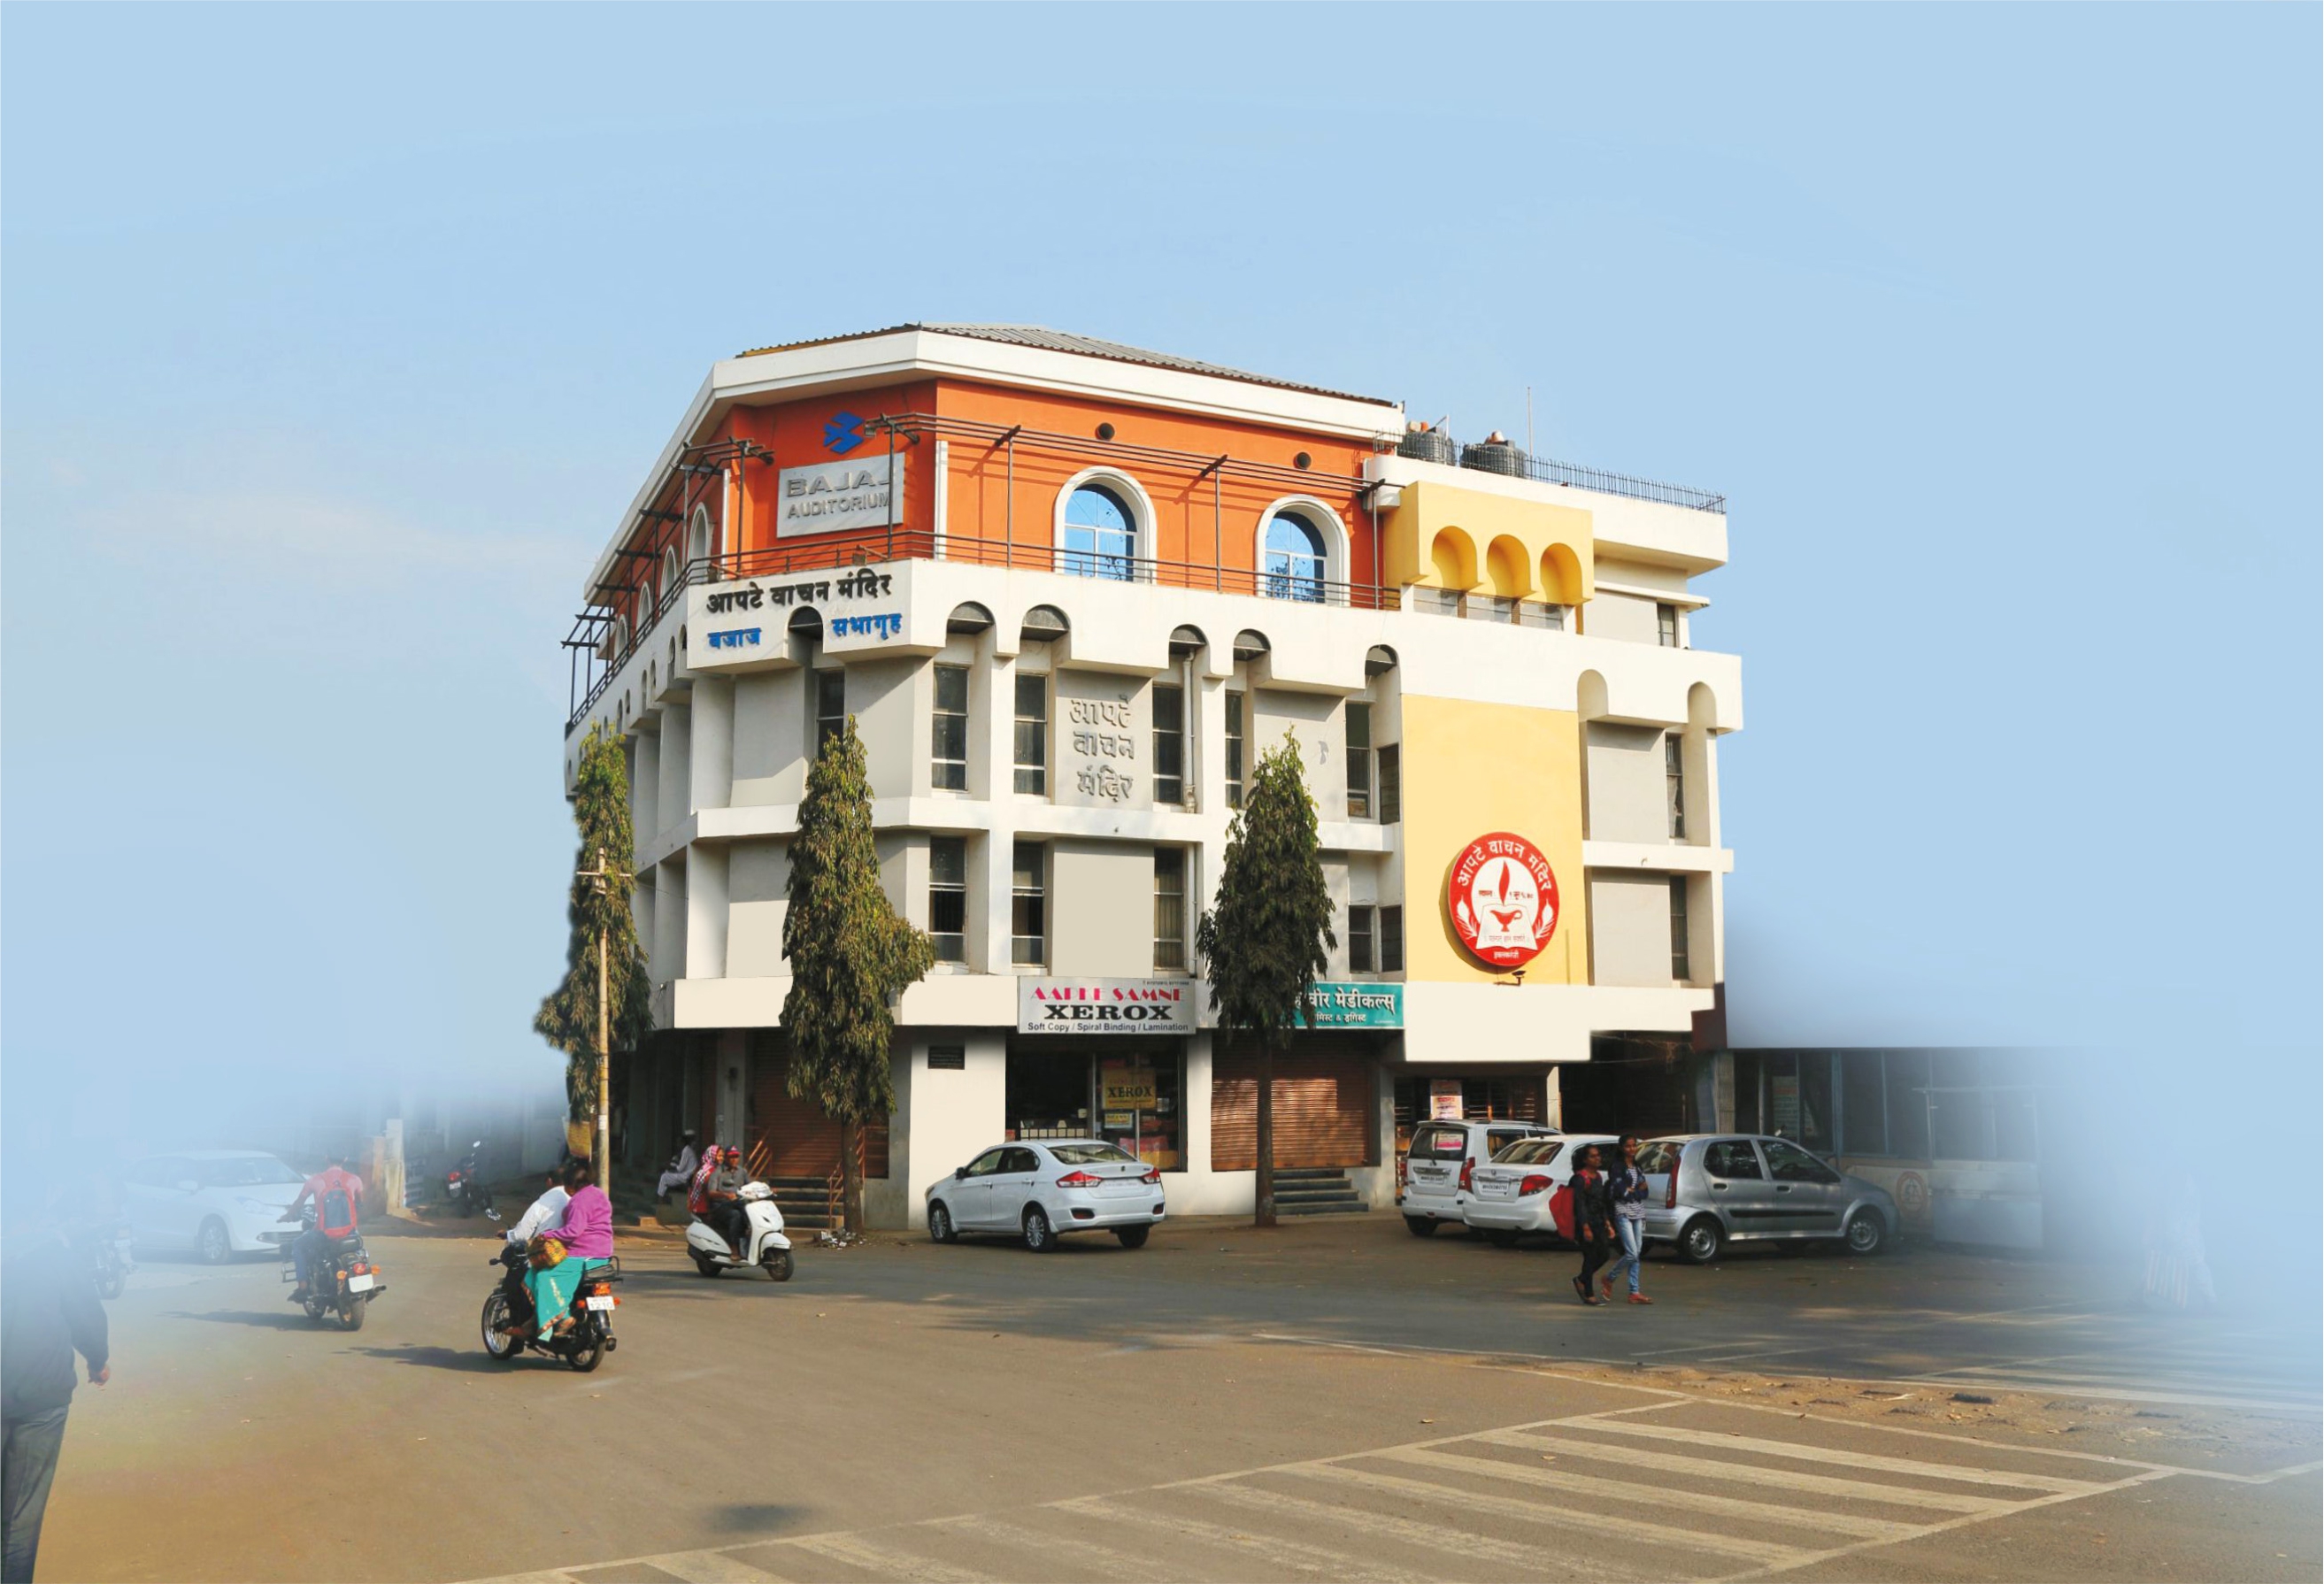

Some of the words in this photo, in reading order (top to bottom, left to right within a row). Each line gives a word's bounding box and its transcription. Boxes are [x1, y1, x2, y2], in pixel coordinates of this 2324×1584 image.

[787, 492, 890, 519] AUDITORIUM
[706, 581, 764, 613] आपटे
[770, 581, 830, 606] वाचन
[836, 567, 893, 599] मंदिर
[707, 627, 762, 650] बजाज
[831, 612, 903, 640] सभागृह
[1069, 694, 1132, 728] आपटे
[1073, 730, 1135, 759] वाचन
[1076, 765, 1133, 802] मंदिर
[1458, 844, 1487, 887] आपटे
[1488, 840, 1525, 858] वाचन
[1528, 853, 1552, 891] मंदिर
[1044, 1003, 1173, 1020] XEROX
[1027, 1022, 1045, 1031] Soft
[1048, 1023, 1070, 1033] Copy
[1077, 1022, 1102, 1033] Spiral
[1104, 1023, 1136, 1033] Binding
[1143, 1023, 1189, 1032] Lamination
[1108, 1086, 1152, 1097] XEROX
